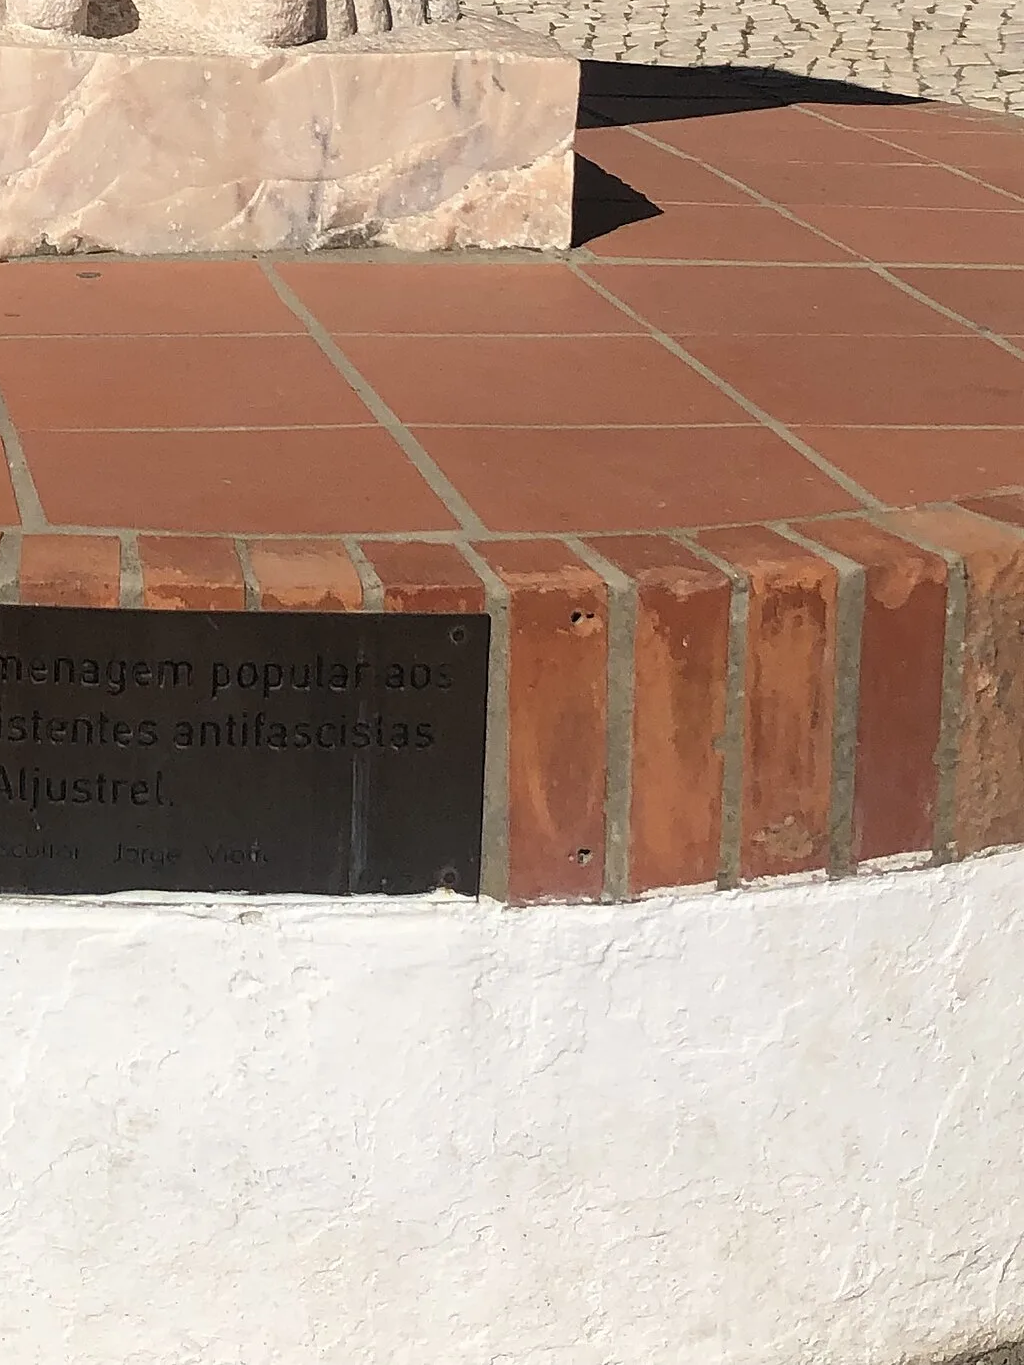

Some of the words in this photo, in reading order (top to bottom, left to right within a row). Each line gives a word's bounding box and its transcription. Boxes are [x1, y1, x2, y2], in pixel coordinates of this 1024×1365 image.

[210, 655, 370, 699] popular
[384, 662, 455, 691] aos
[173, 710, 436, 751] antifascistas
